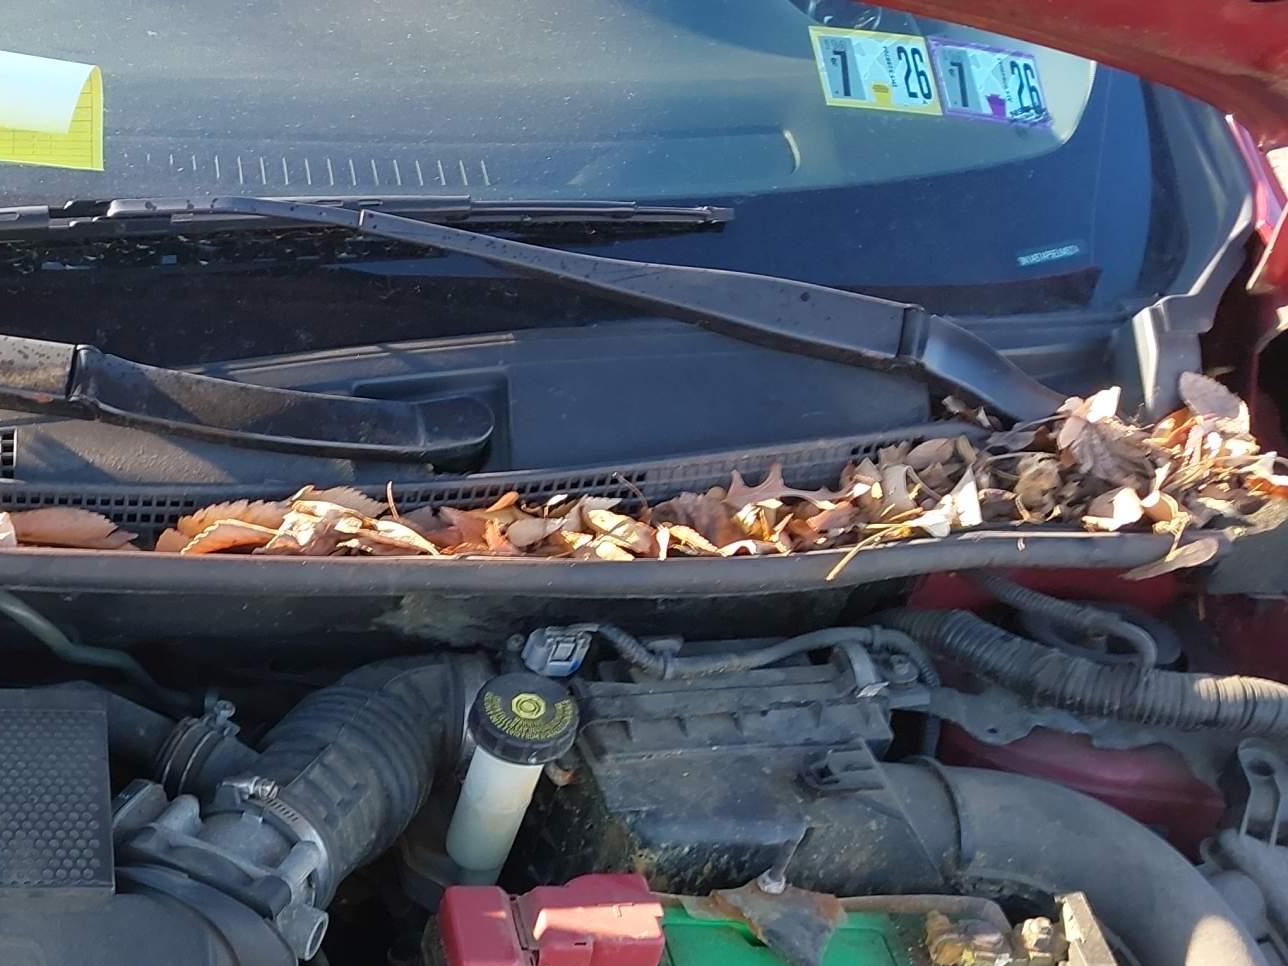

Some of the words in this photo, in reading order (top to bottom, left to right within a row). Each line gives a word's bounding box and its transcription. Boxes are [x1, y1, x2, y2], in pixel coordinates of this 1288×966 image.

[832, 49, 851, 97] 7
[897, 46, 932, 100] 26
[950, 61, 969, 108] 7
[1010, 60, 1045, 114] 26
